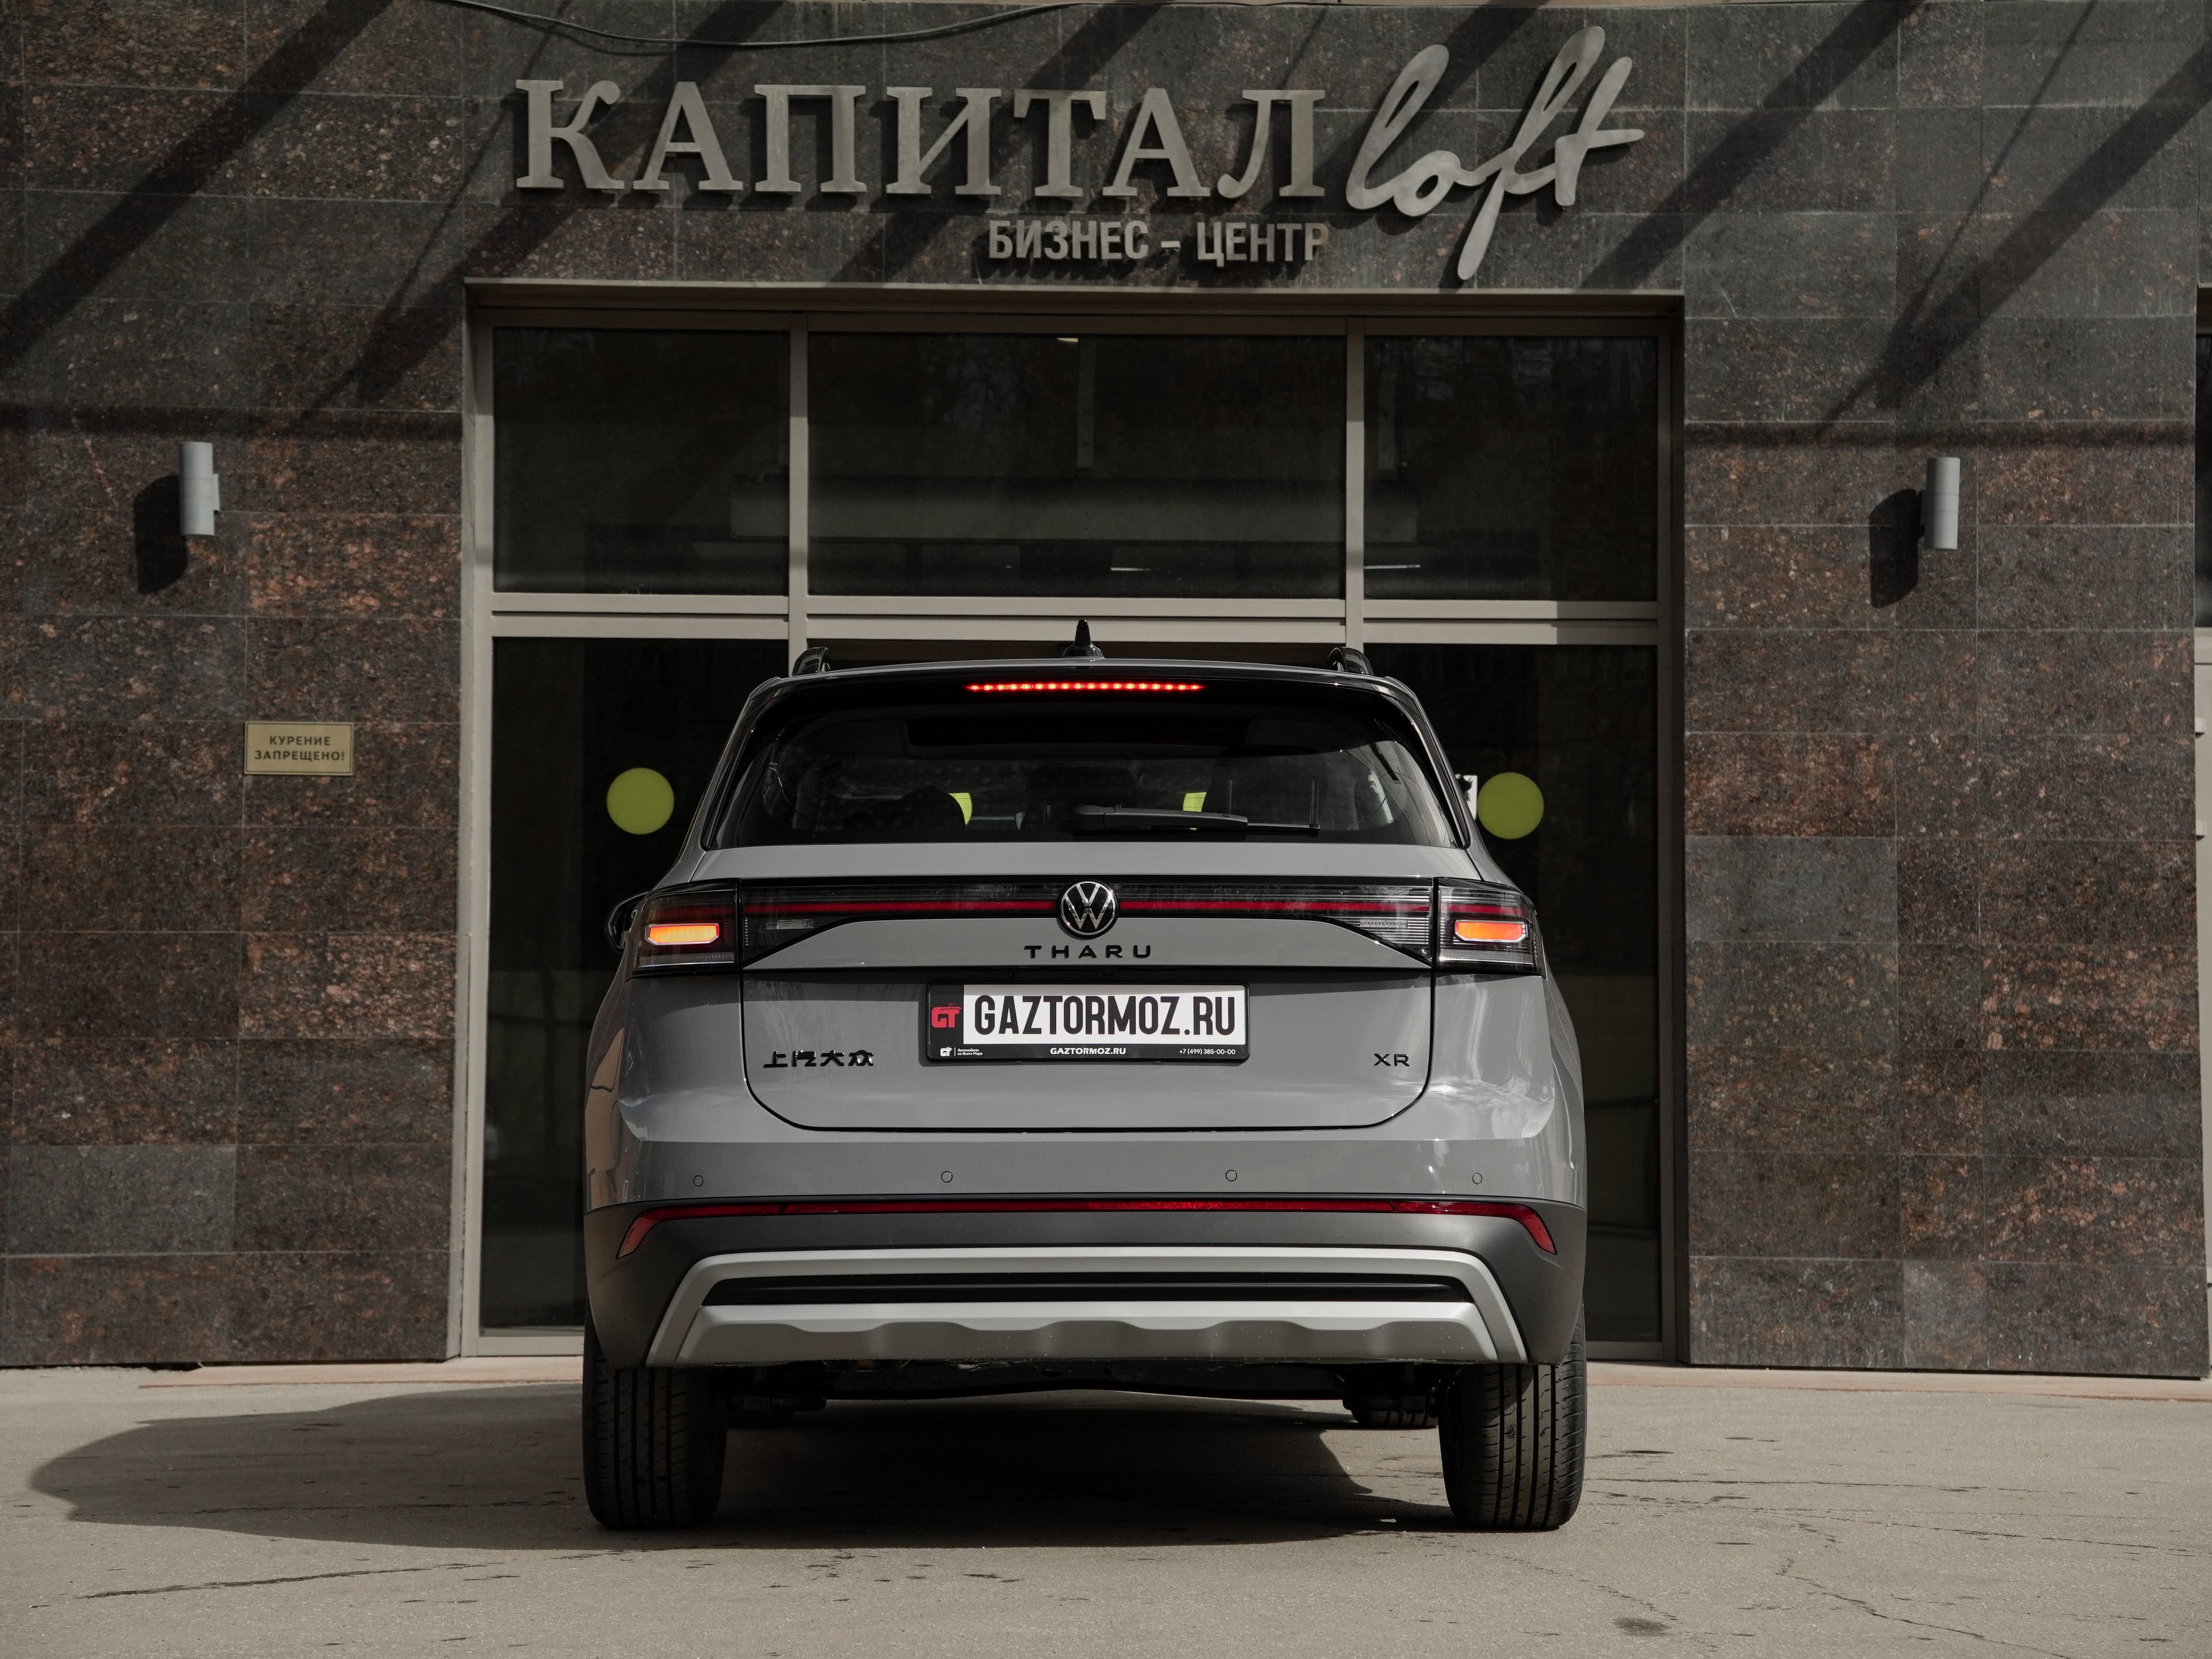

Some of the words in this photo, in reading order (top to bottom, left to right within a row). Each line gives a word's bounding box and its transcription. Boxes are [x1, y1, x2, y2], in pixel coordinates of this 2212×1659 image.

[516, 79, 1325, 198] КАПИТАЛ
[1346, 26, 1645, 281] loft
[988, 220, 1149, 260] БИЗНЕС
[1197, 221, 1329, 267] ЦЕНТР
[269, 735, 331, 746] КУРЕНИЕ
[254, 750, 345, 762] ЗАПРЕЩЕНО!
[1023, 944, 1151, 959] THARU
[931, 1005, 961, 1028] GT
[974, 995, 1235, 1036] GAZTORMOZ.RU
[1374, 1053, 1410, 1067] XR
